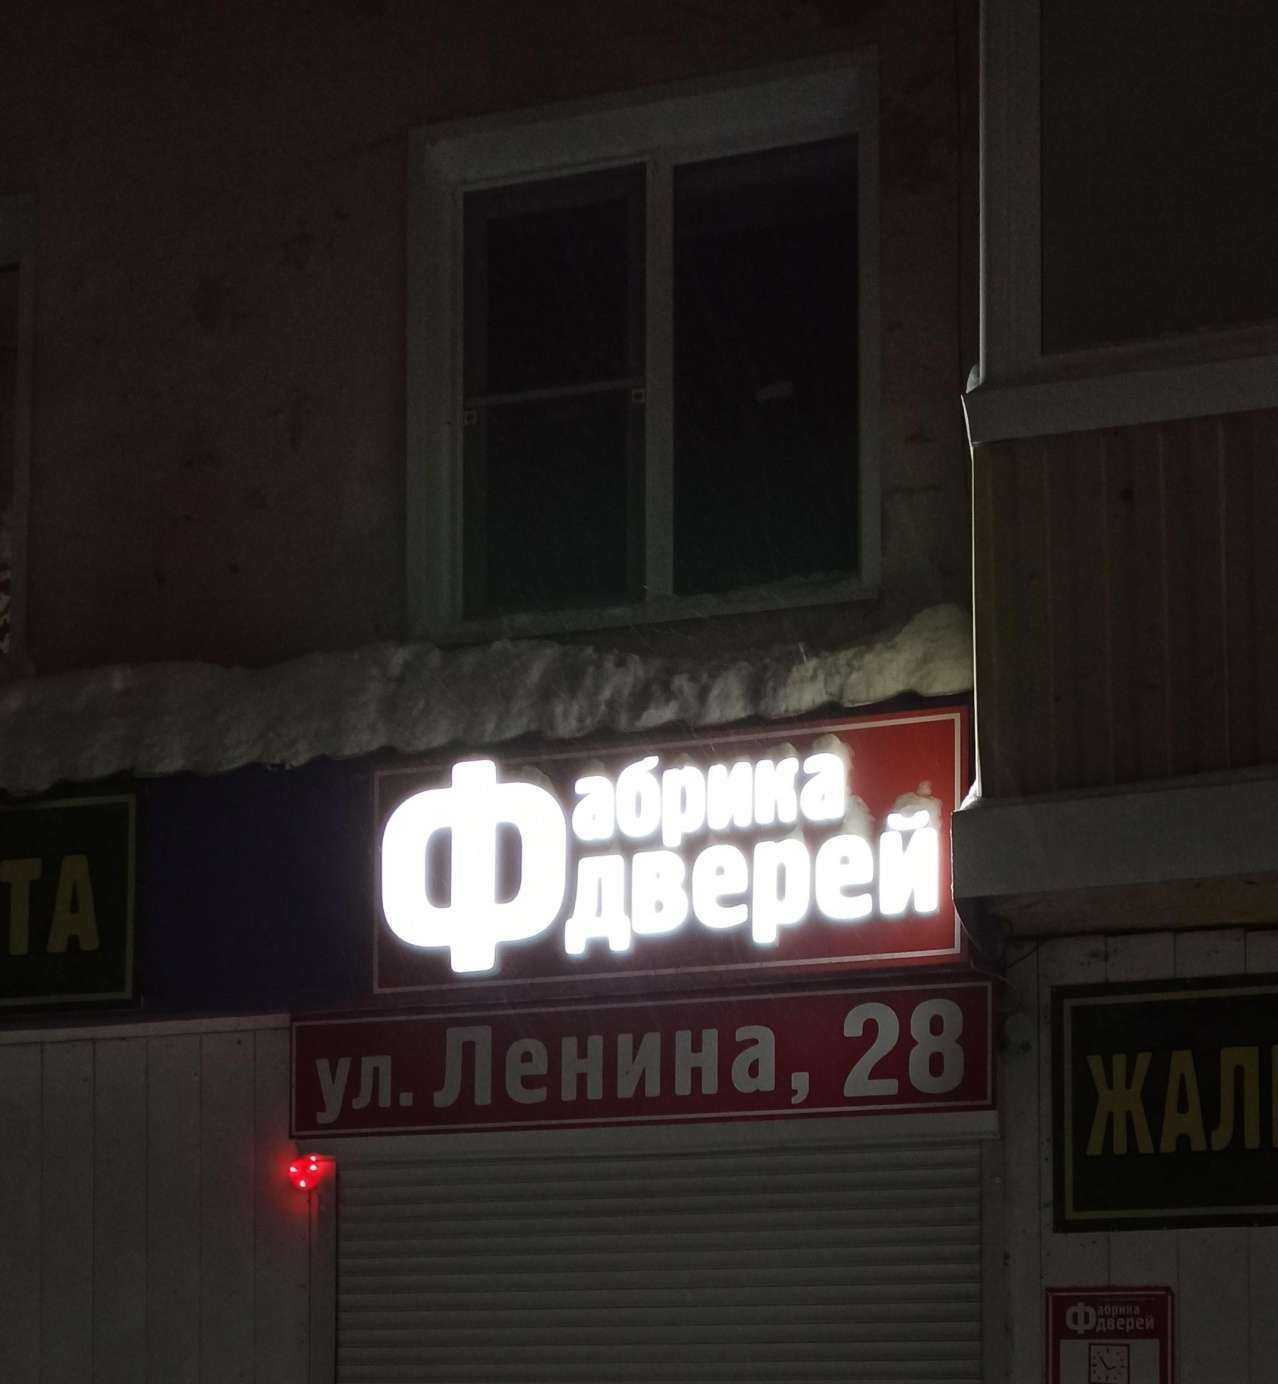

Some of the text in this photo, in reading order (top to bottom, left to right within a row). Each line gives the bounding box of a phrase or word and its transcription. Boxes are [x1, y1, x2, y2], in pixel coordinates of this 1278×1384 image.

[0, 853, 100, 957] ТА
[564, 809, 941, 956] дверей
[314, 998, 966, 1125] ул. Ленина, 28
[1085, 1044, 1278, 1156] ЖАЛ
